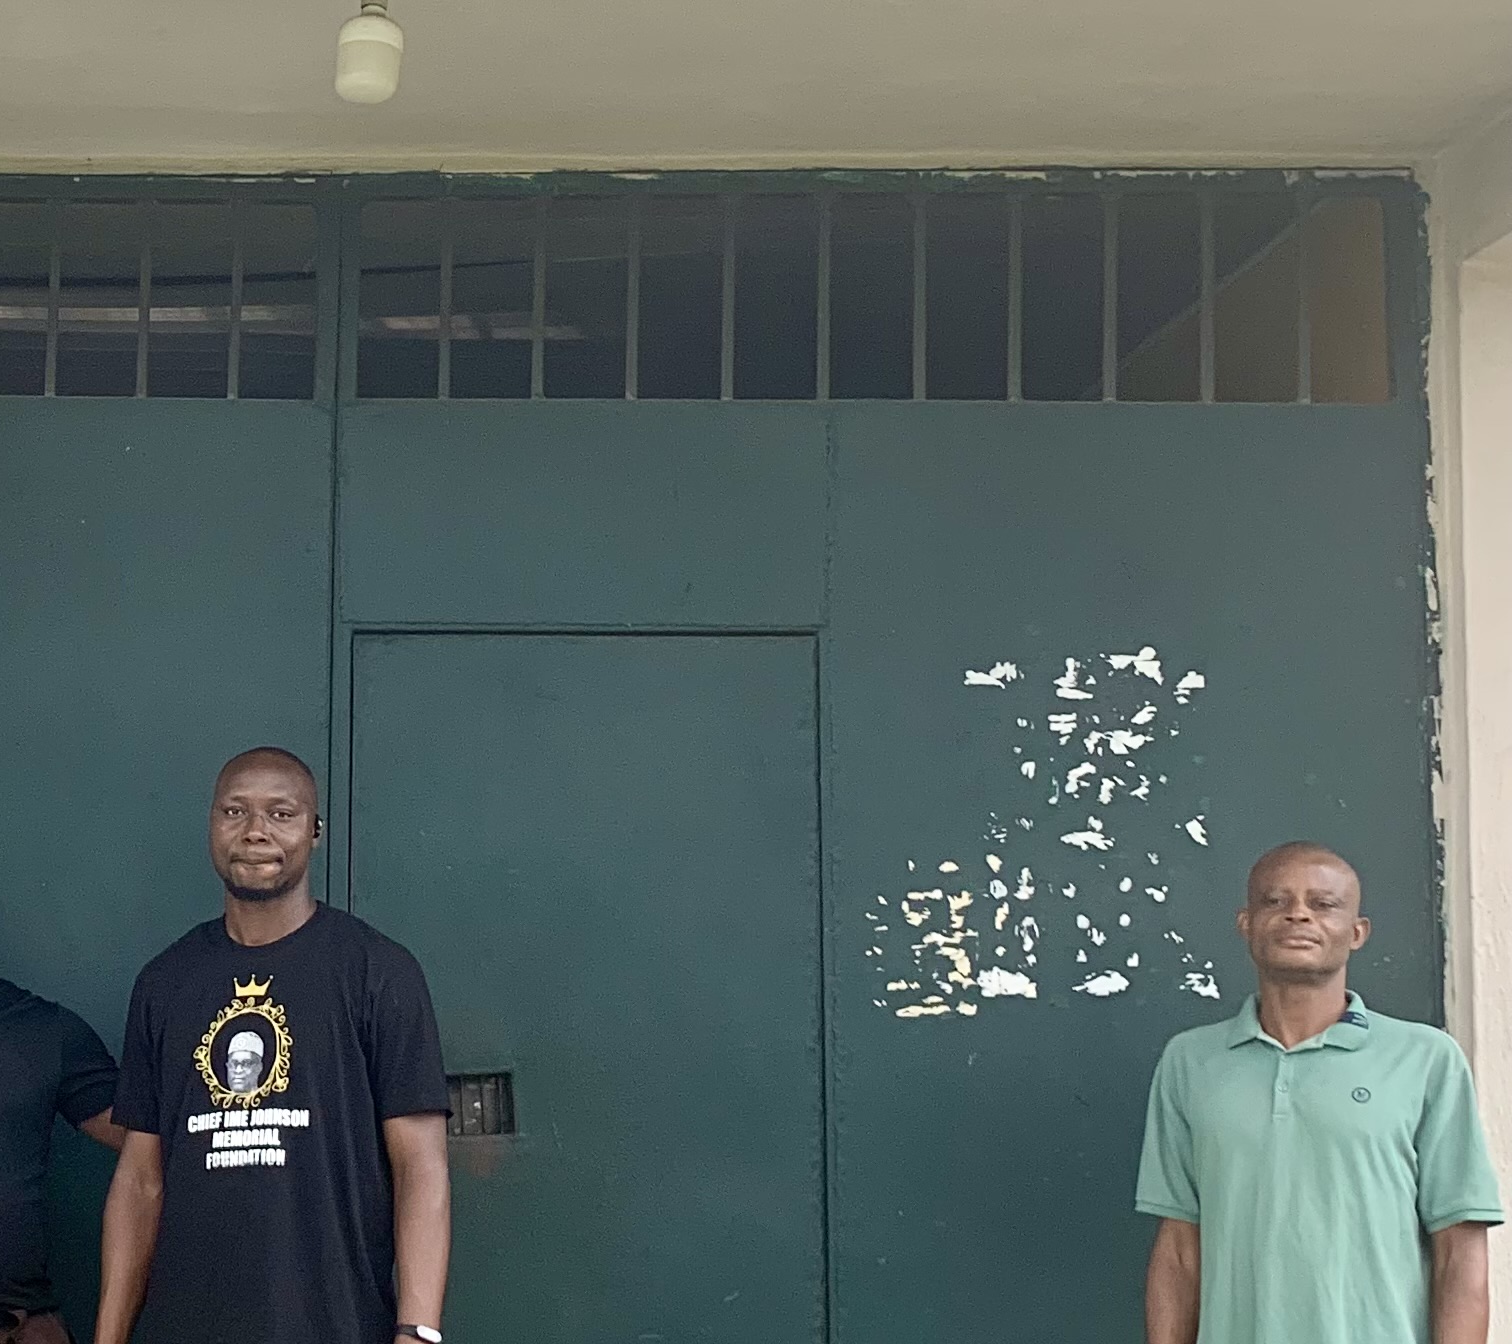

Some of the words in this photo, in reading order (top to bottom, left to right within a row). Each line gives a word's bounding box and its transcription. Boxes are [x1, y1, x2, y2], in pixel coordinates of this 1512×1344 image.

[188, 1111, 223, 1133] CHIEF
[224, 1110, 249, 1128] IME
[250, 1108, 309, 1127] JOHNSON
[212, 1128, 281, 1148] MEMORIAL
[206, 1148, 286, 1170] FOUNDATION
